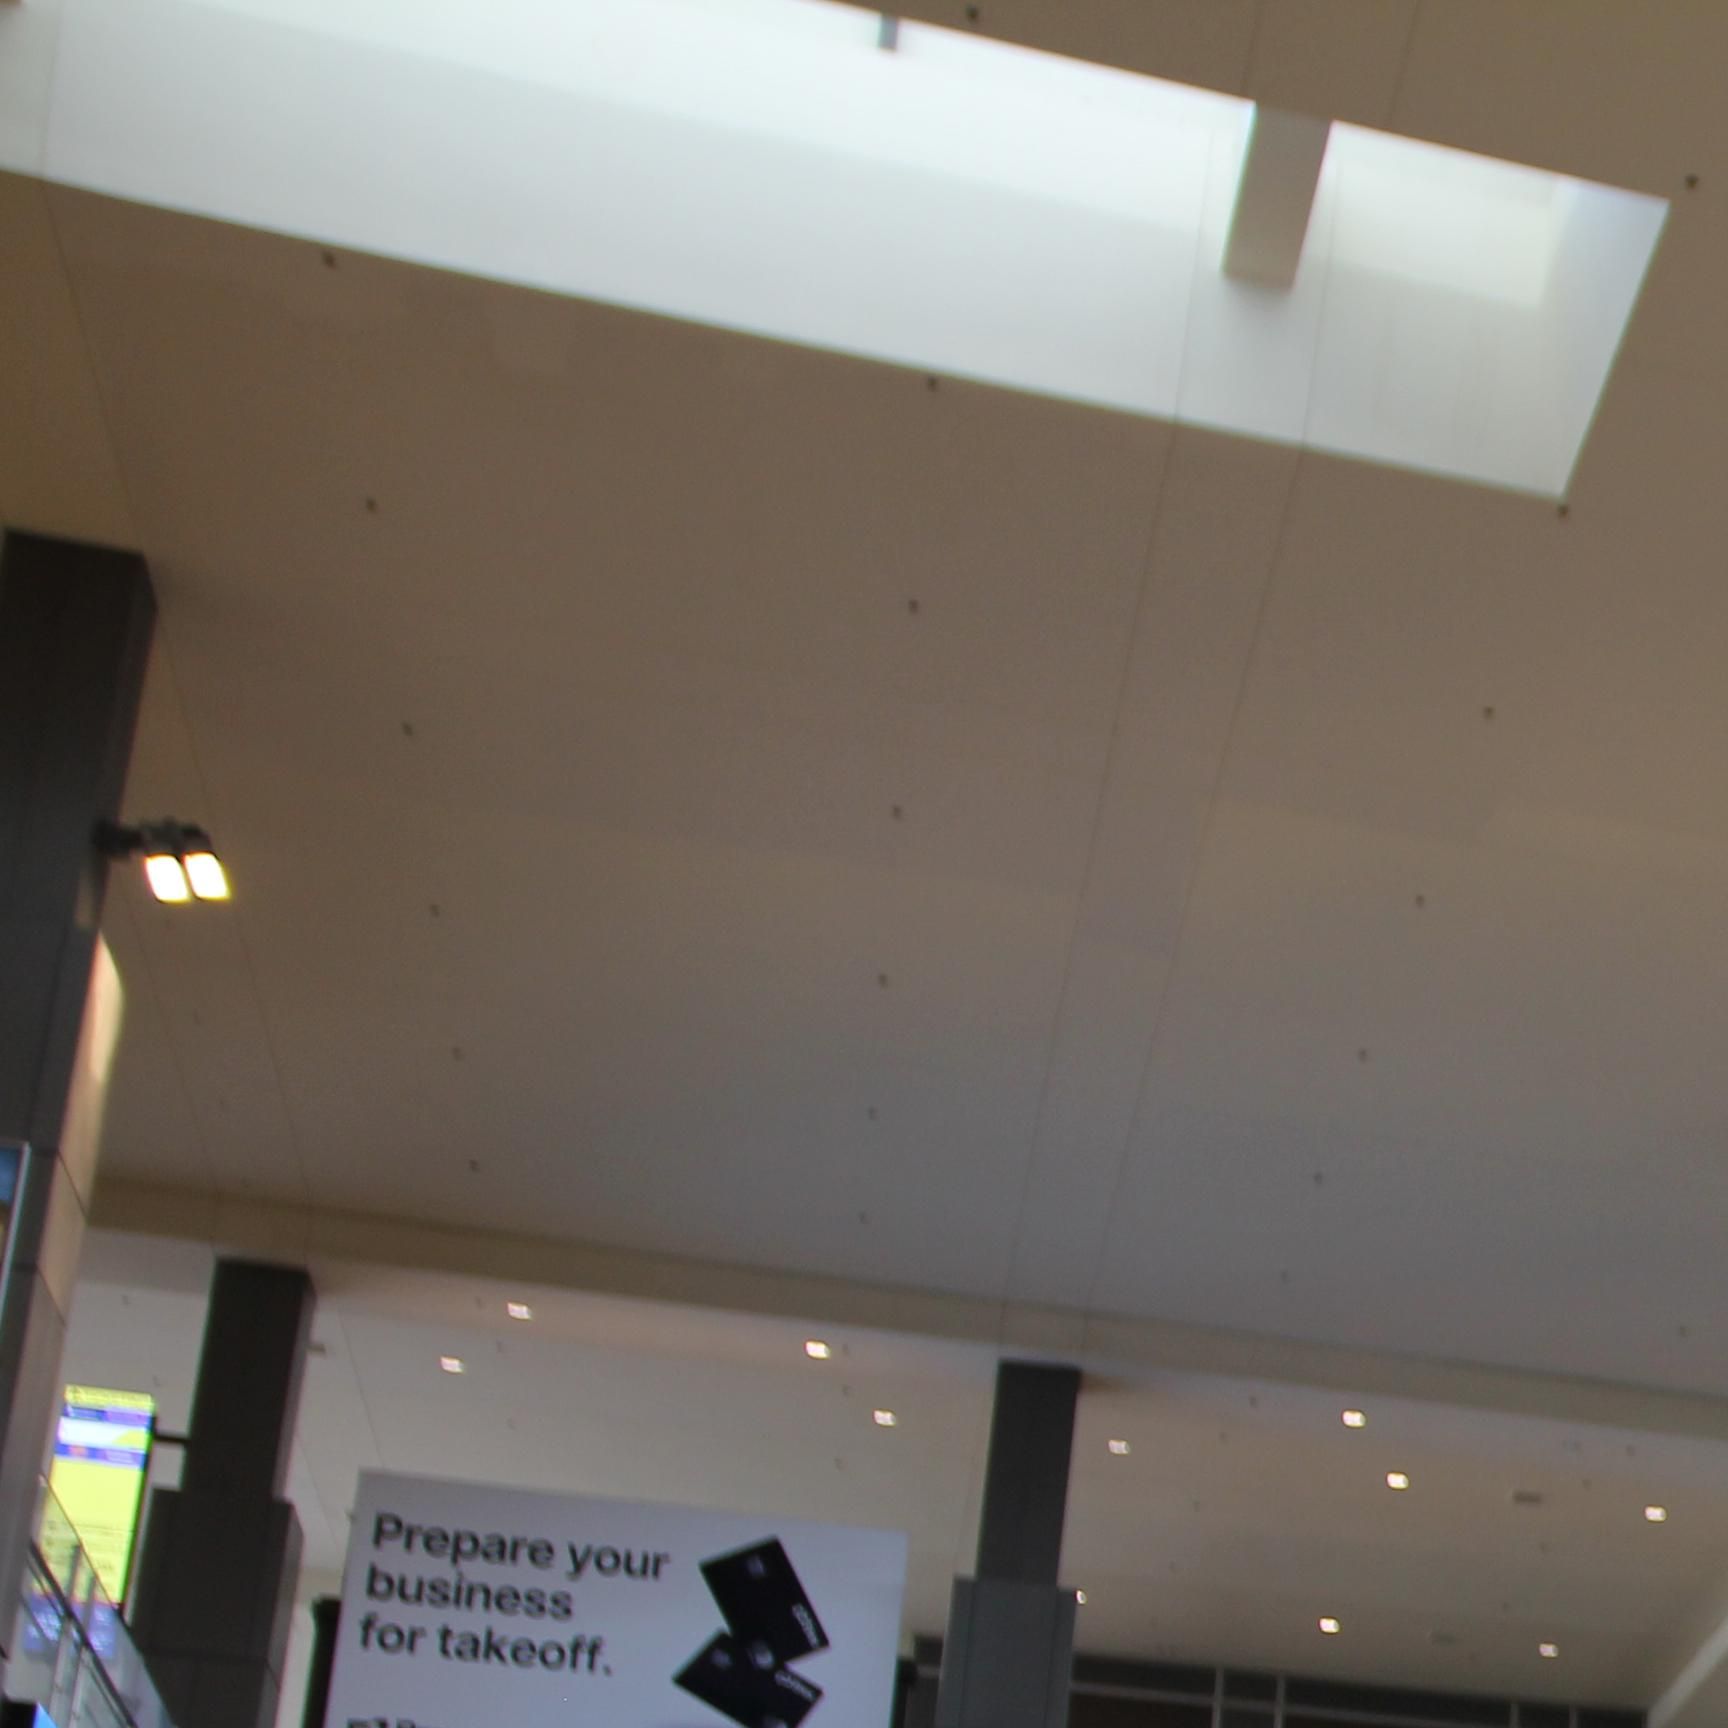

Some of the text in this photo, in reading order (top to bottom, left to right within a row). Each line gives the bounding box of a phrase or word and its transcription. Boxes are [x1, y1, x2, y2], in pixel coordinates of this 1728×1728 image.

[371, 1511, 671, 1581] Prepare your
[364, 1562, 575, 1621] business
[357, 1611, 614, 1678] for takeoff.
